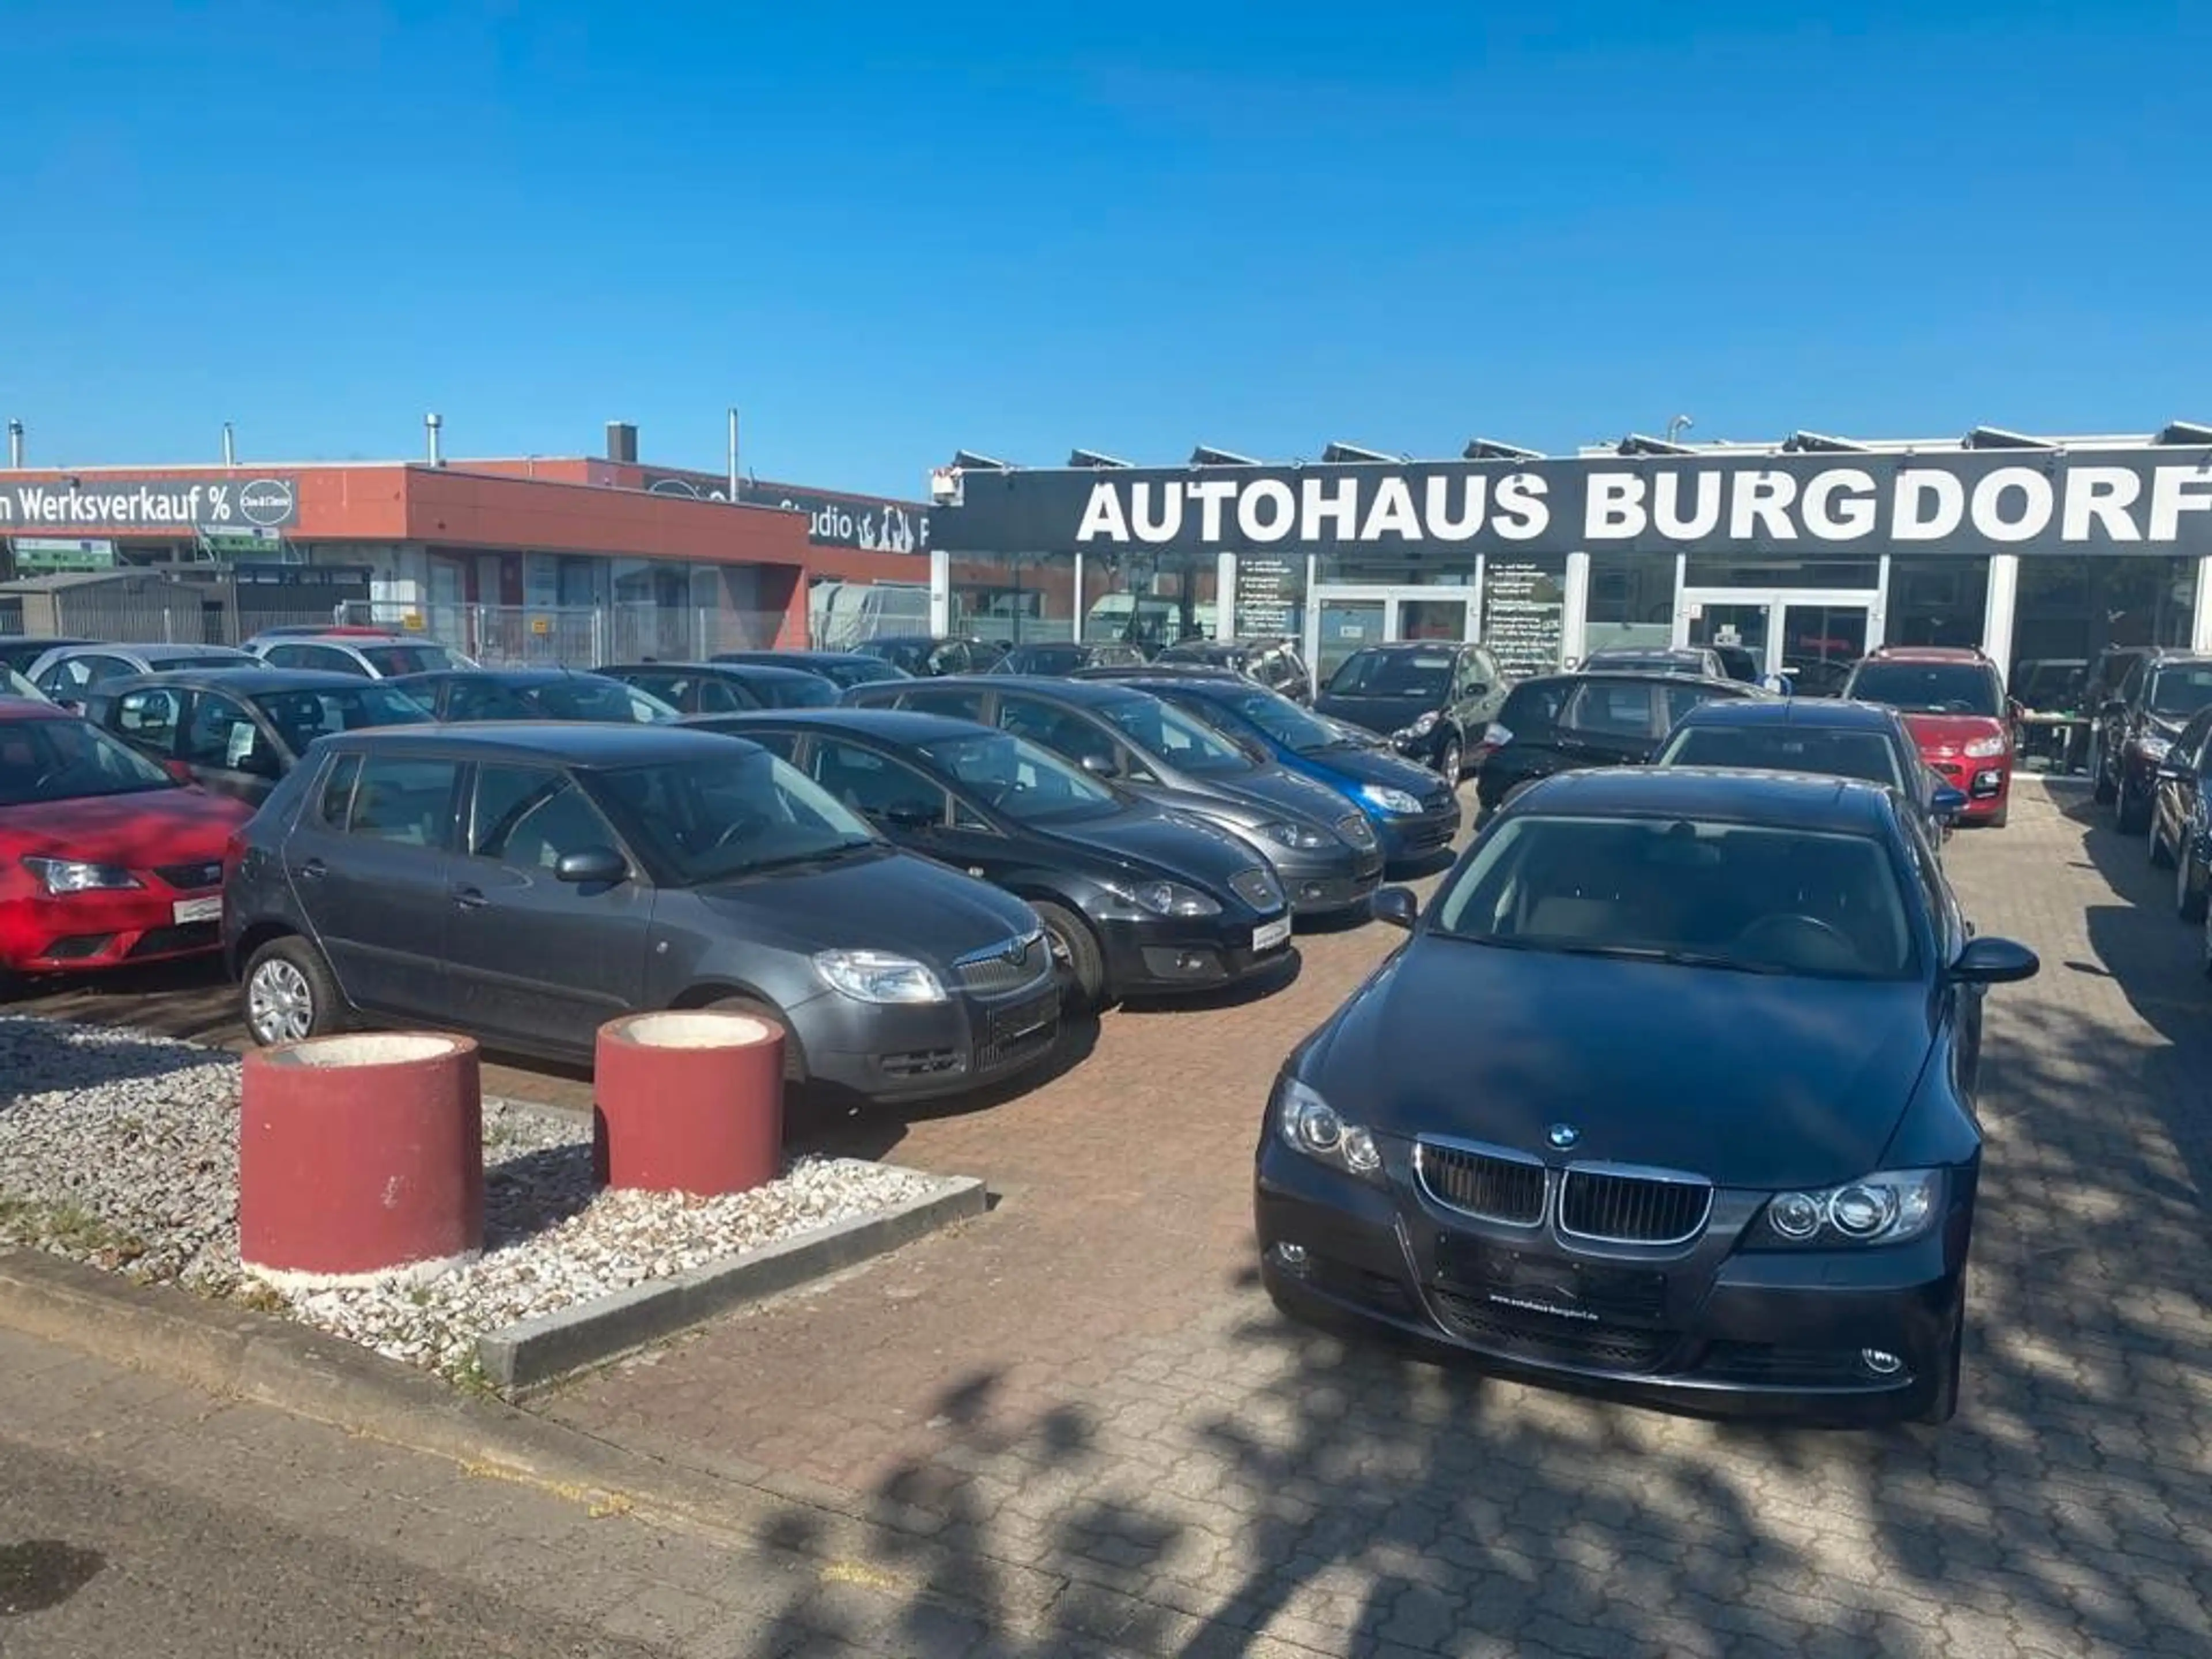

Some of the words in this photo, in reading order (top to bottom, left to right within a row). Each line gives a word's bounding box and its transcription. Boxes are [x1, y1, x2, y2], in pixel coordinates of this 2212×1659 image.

[17, 484, 202, 521] Werksverkauf
[209, 485, 230, 521] %
[1077, 472, 1550, 542] AUTOHAUS
[1585, 465, 2212, 541] BURGDORF
